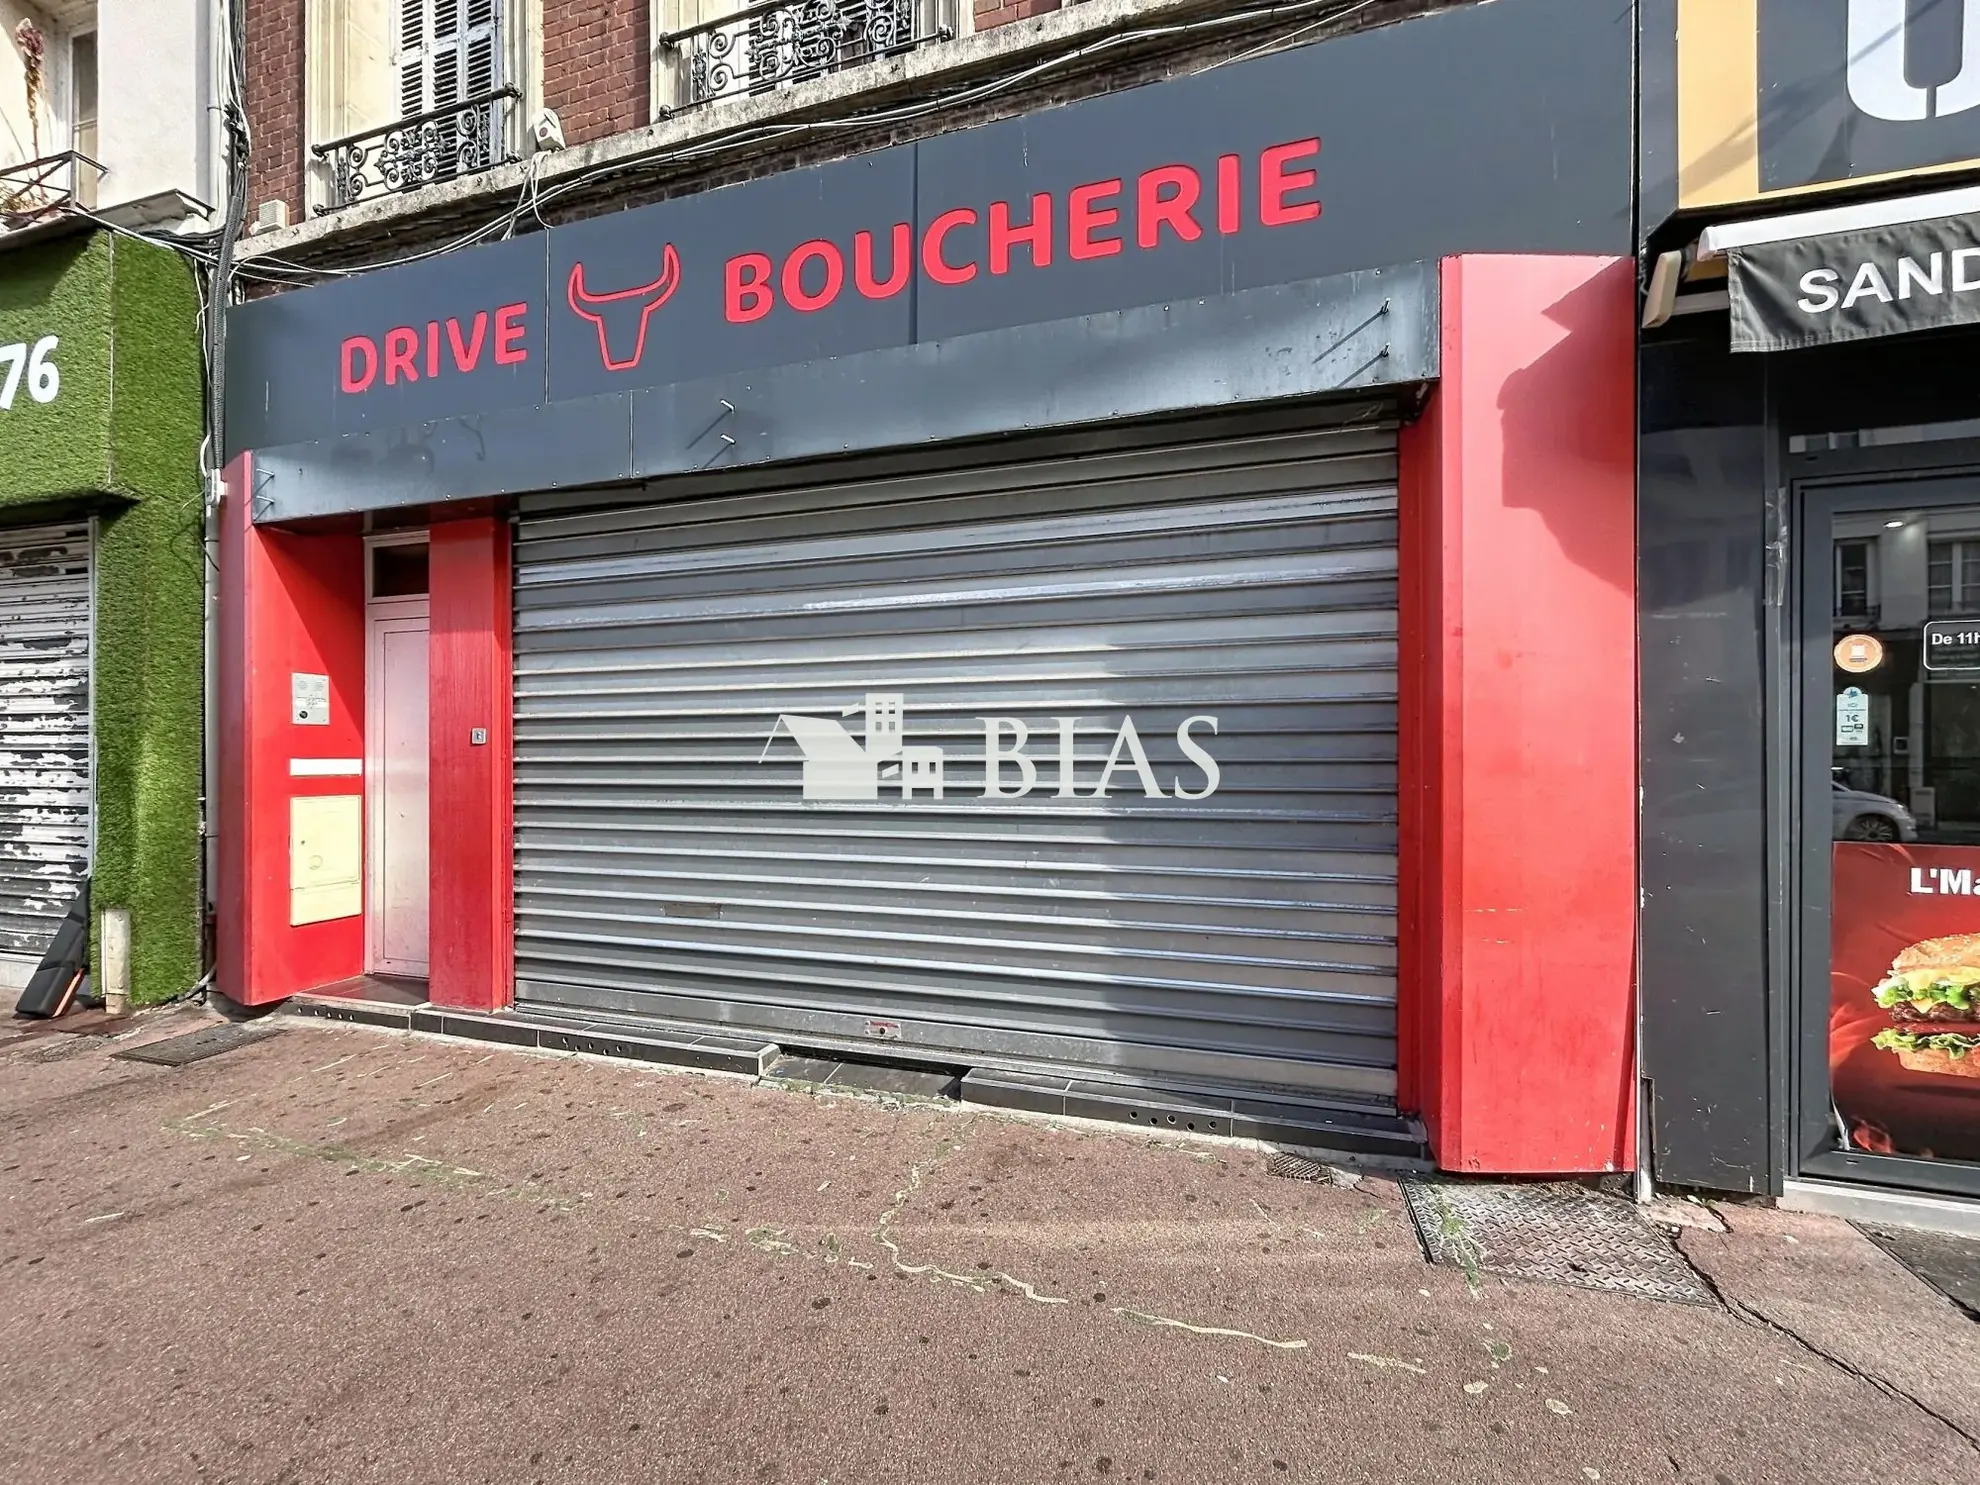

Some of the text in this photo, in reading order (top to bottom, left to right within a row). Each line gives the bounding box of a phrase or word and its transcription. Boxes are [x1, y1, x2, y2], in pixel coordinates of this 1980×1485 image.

[340, 136, 1322, 394] DRIVE BOUCHERIE
[0, 334, 60, 410] 76
[1931, 633, 1953, 645] De
